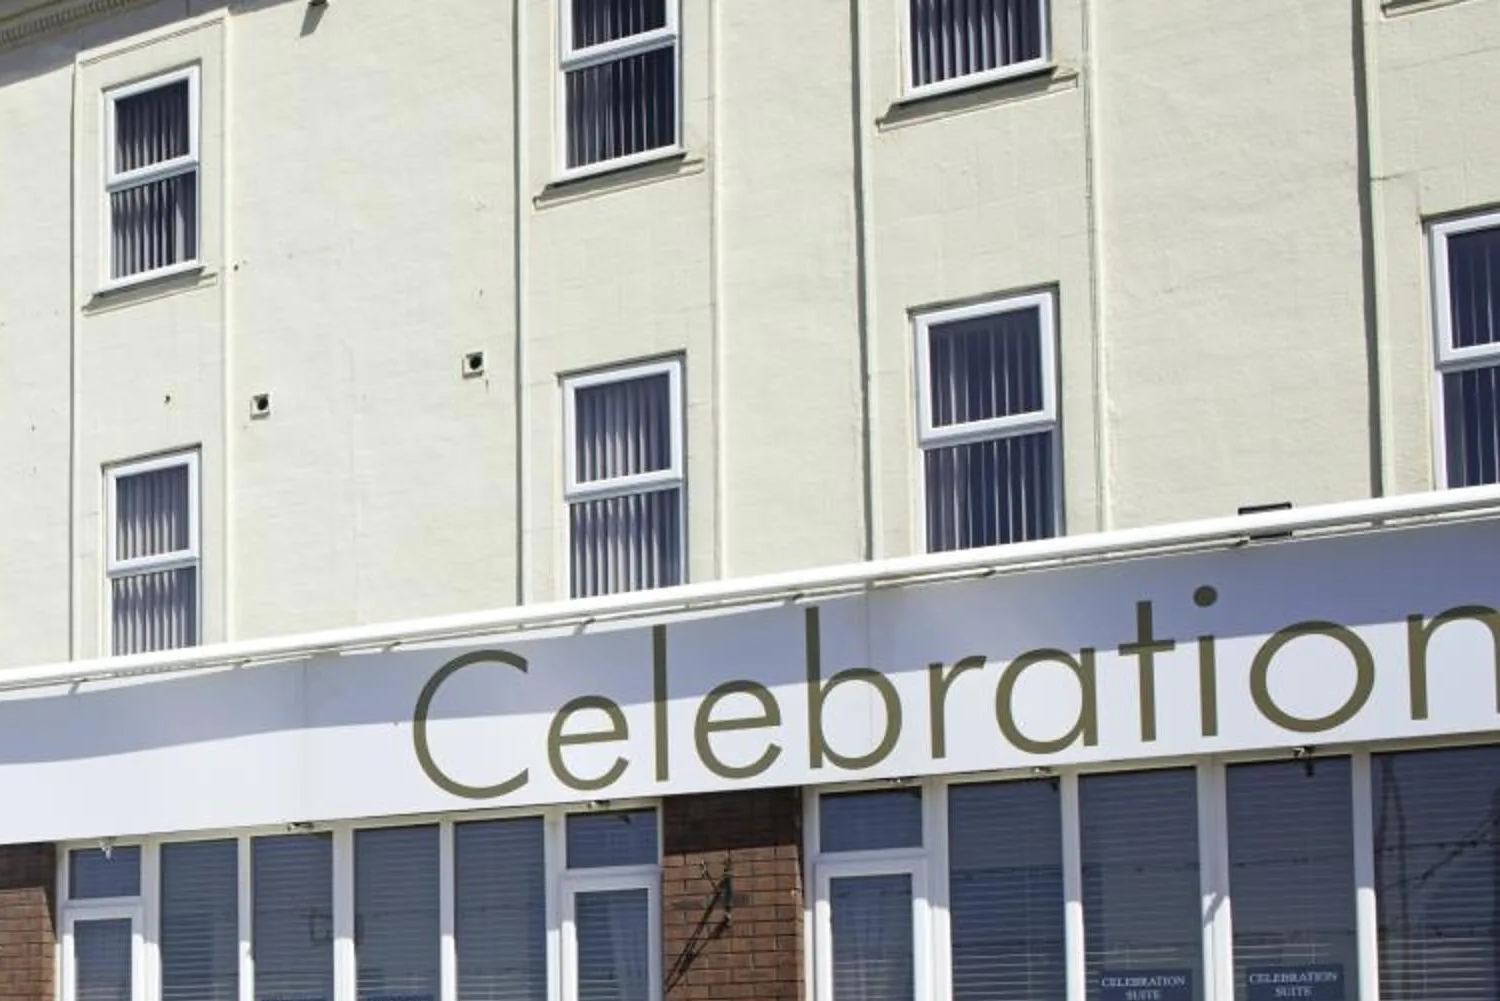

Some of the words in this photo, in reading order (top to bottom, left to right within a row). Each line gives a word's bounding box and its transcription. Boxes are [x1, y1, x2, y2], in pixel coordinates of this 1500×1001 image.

[411, 584, 1500, 799] Celebration
[1101, 976, 1186, 987] CELEBRATION
[1250, 971, 1338, 984] CELEBRATION
[1125, 990, 1162, 1001] SUITE
[1275, 986, 1312, 998] SUITE
